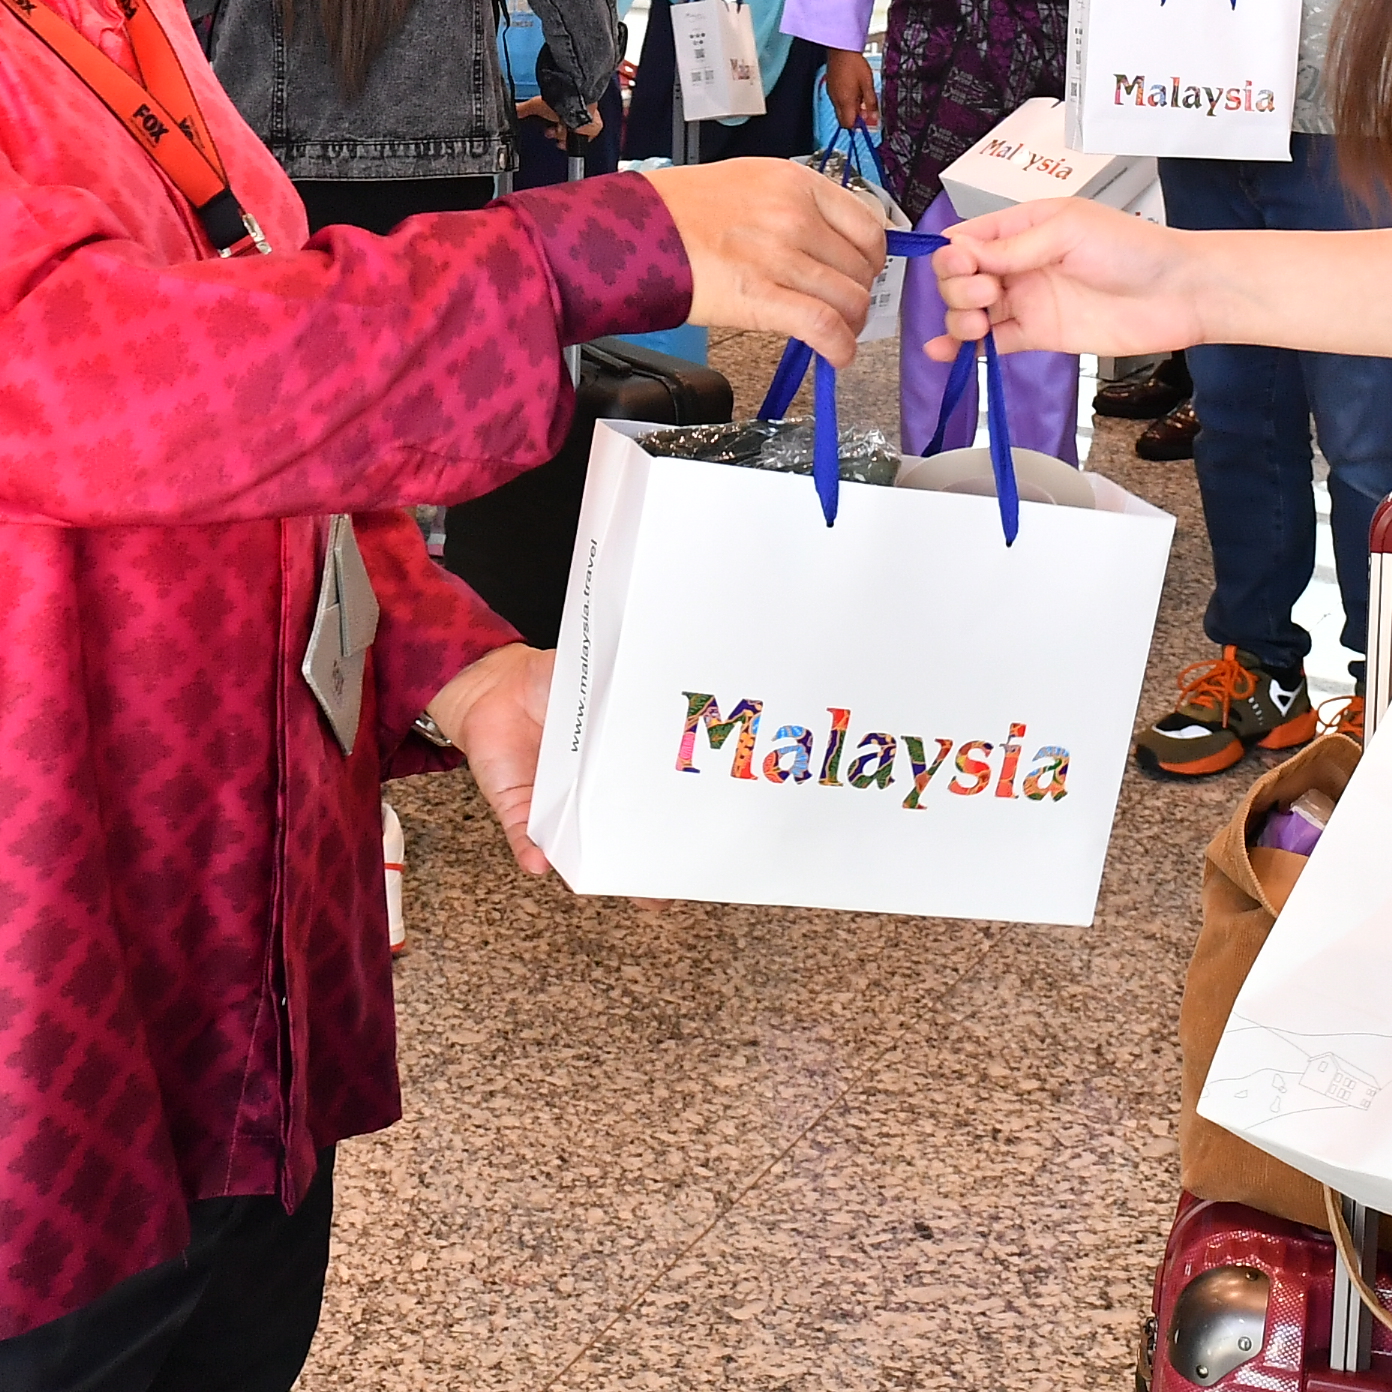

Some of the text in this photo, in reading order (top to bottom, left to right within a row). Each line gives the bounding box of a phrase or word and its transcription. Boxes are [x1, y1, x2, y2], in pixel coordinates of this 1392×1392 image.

[1113, 73, 1276, 117] Malaysia
[132, 103, 170, 144] FOX
[979, 139, 1074, 181] Malysia
[571, 538, 598, 753] www.malaysia.travel
[675, 691, 1071, 810] Malaysia
